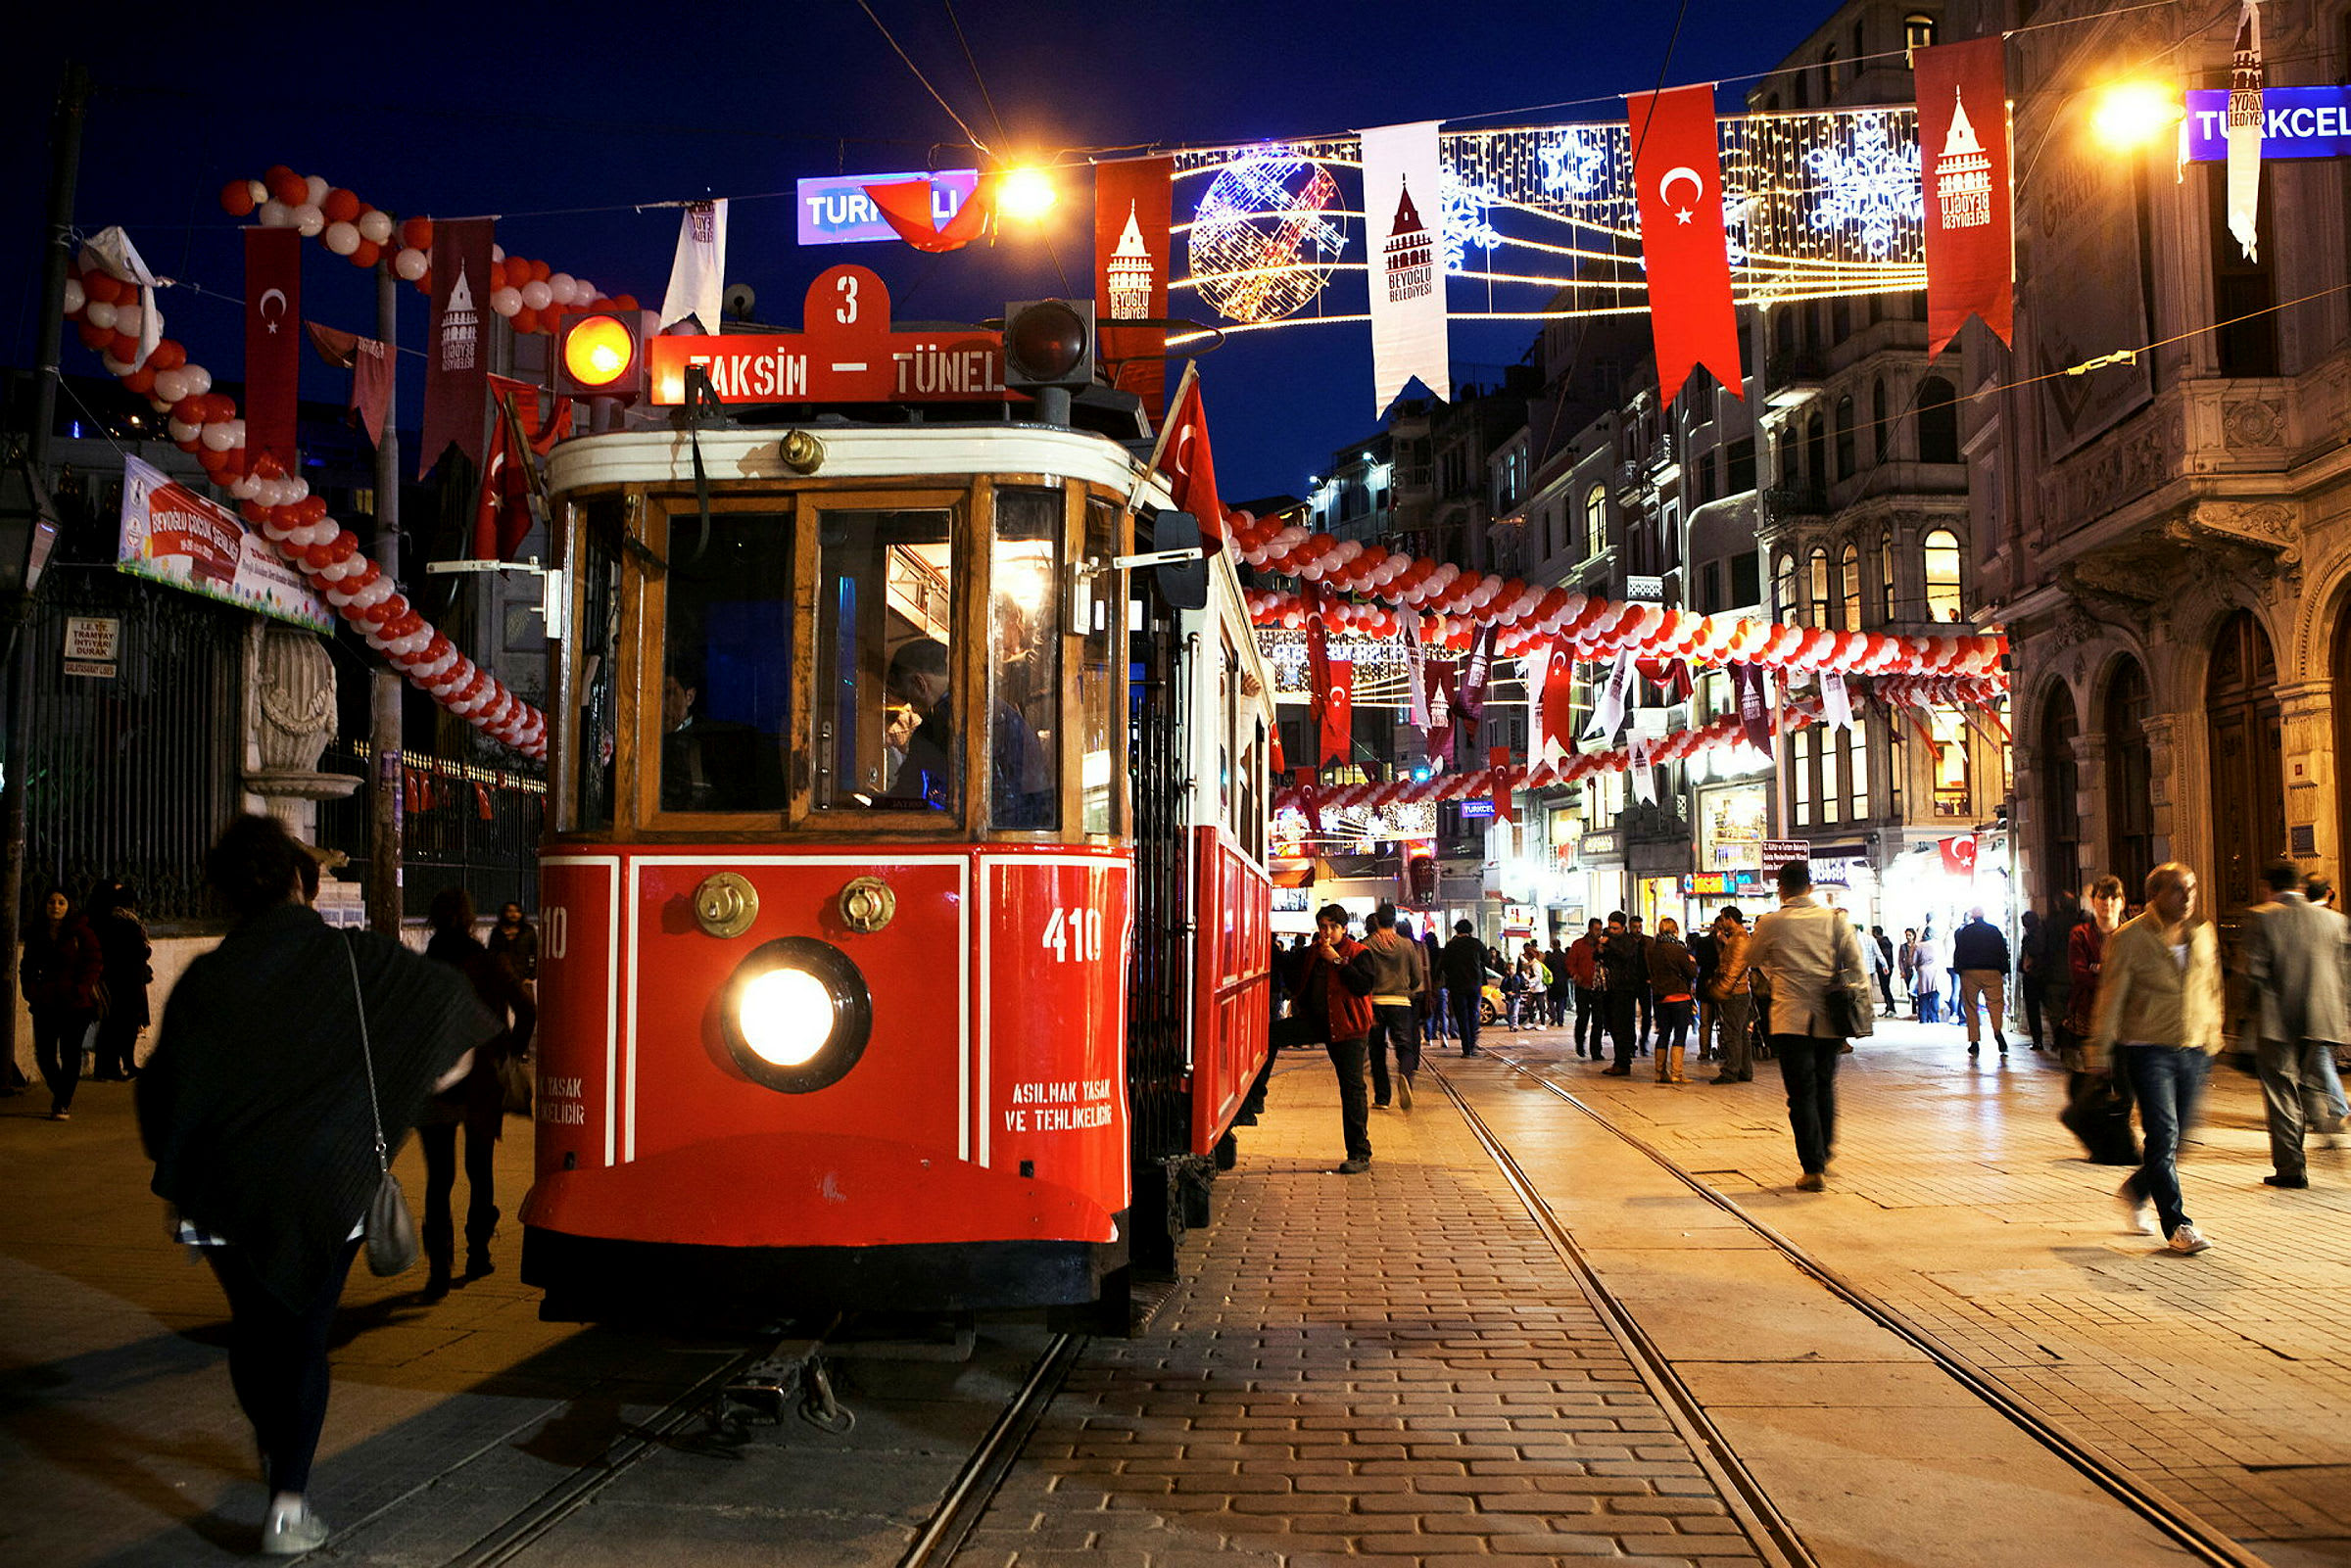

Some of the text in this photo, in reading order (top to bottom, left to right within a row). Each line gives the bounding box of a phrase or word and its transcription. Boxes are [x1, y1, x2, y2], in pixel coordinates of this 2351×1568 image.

[837, 276, 858, 324] 3
[892, 344, 1006, 395] TÜNEL
[76, 646, 108, 656] DURAK
[1042, 907, 1101, 963] 410
[1082, 1078, 1111, 1101] YASAK
[1005, 1102, 1112, 1131] VE TEHLİKELİDİR
